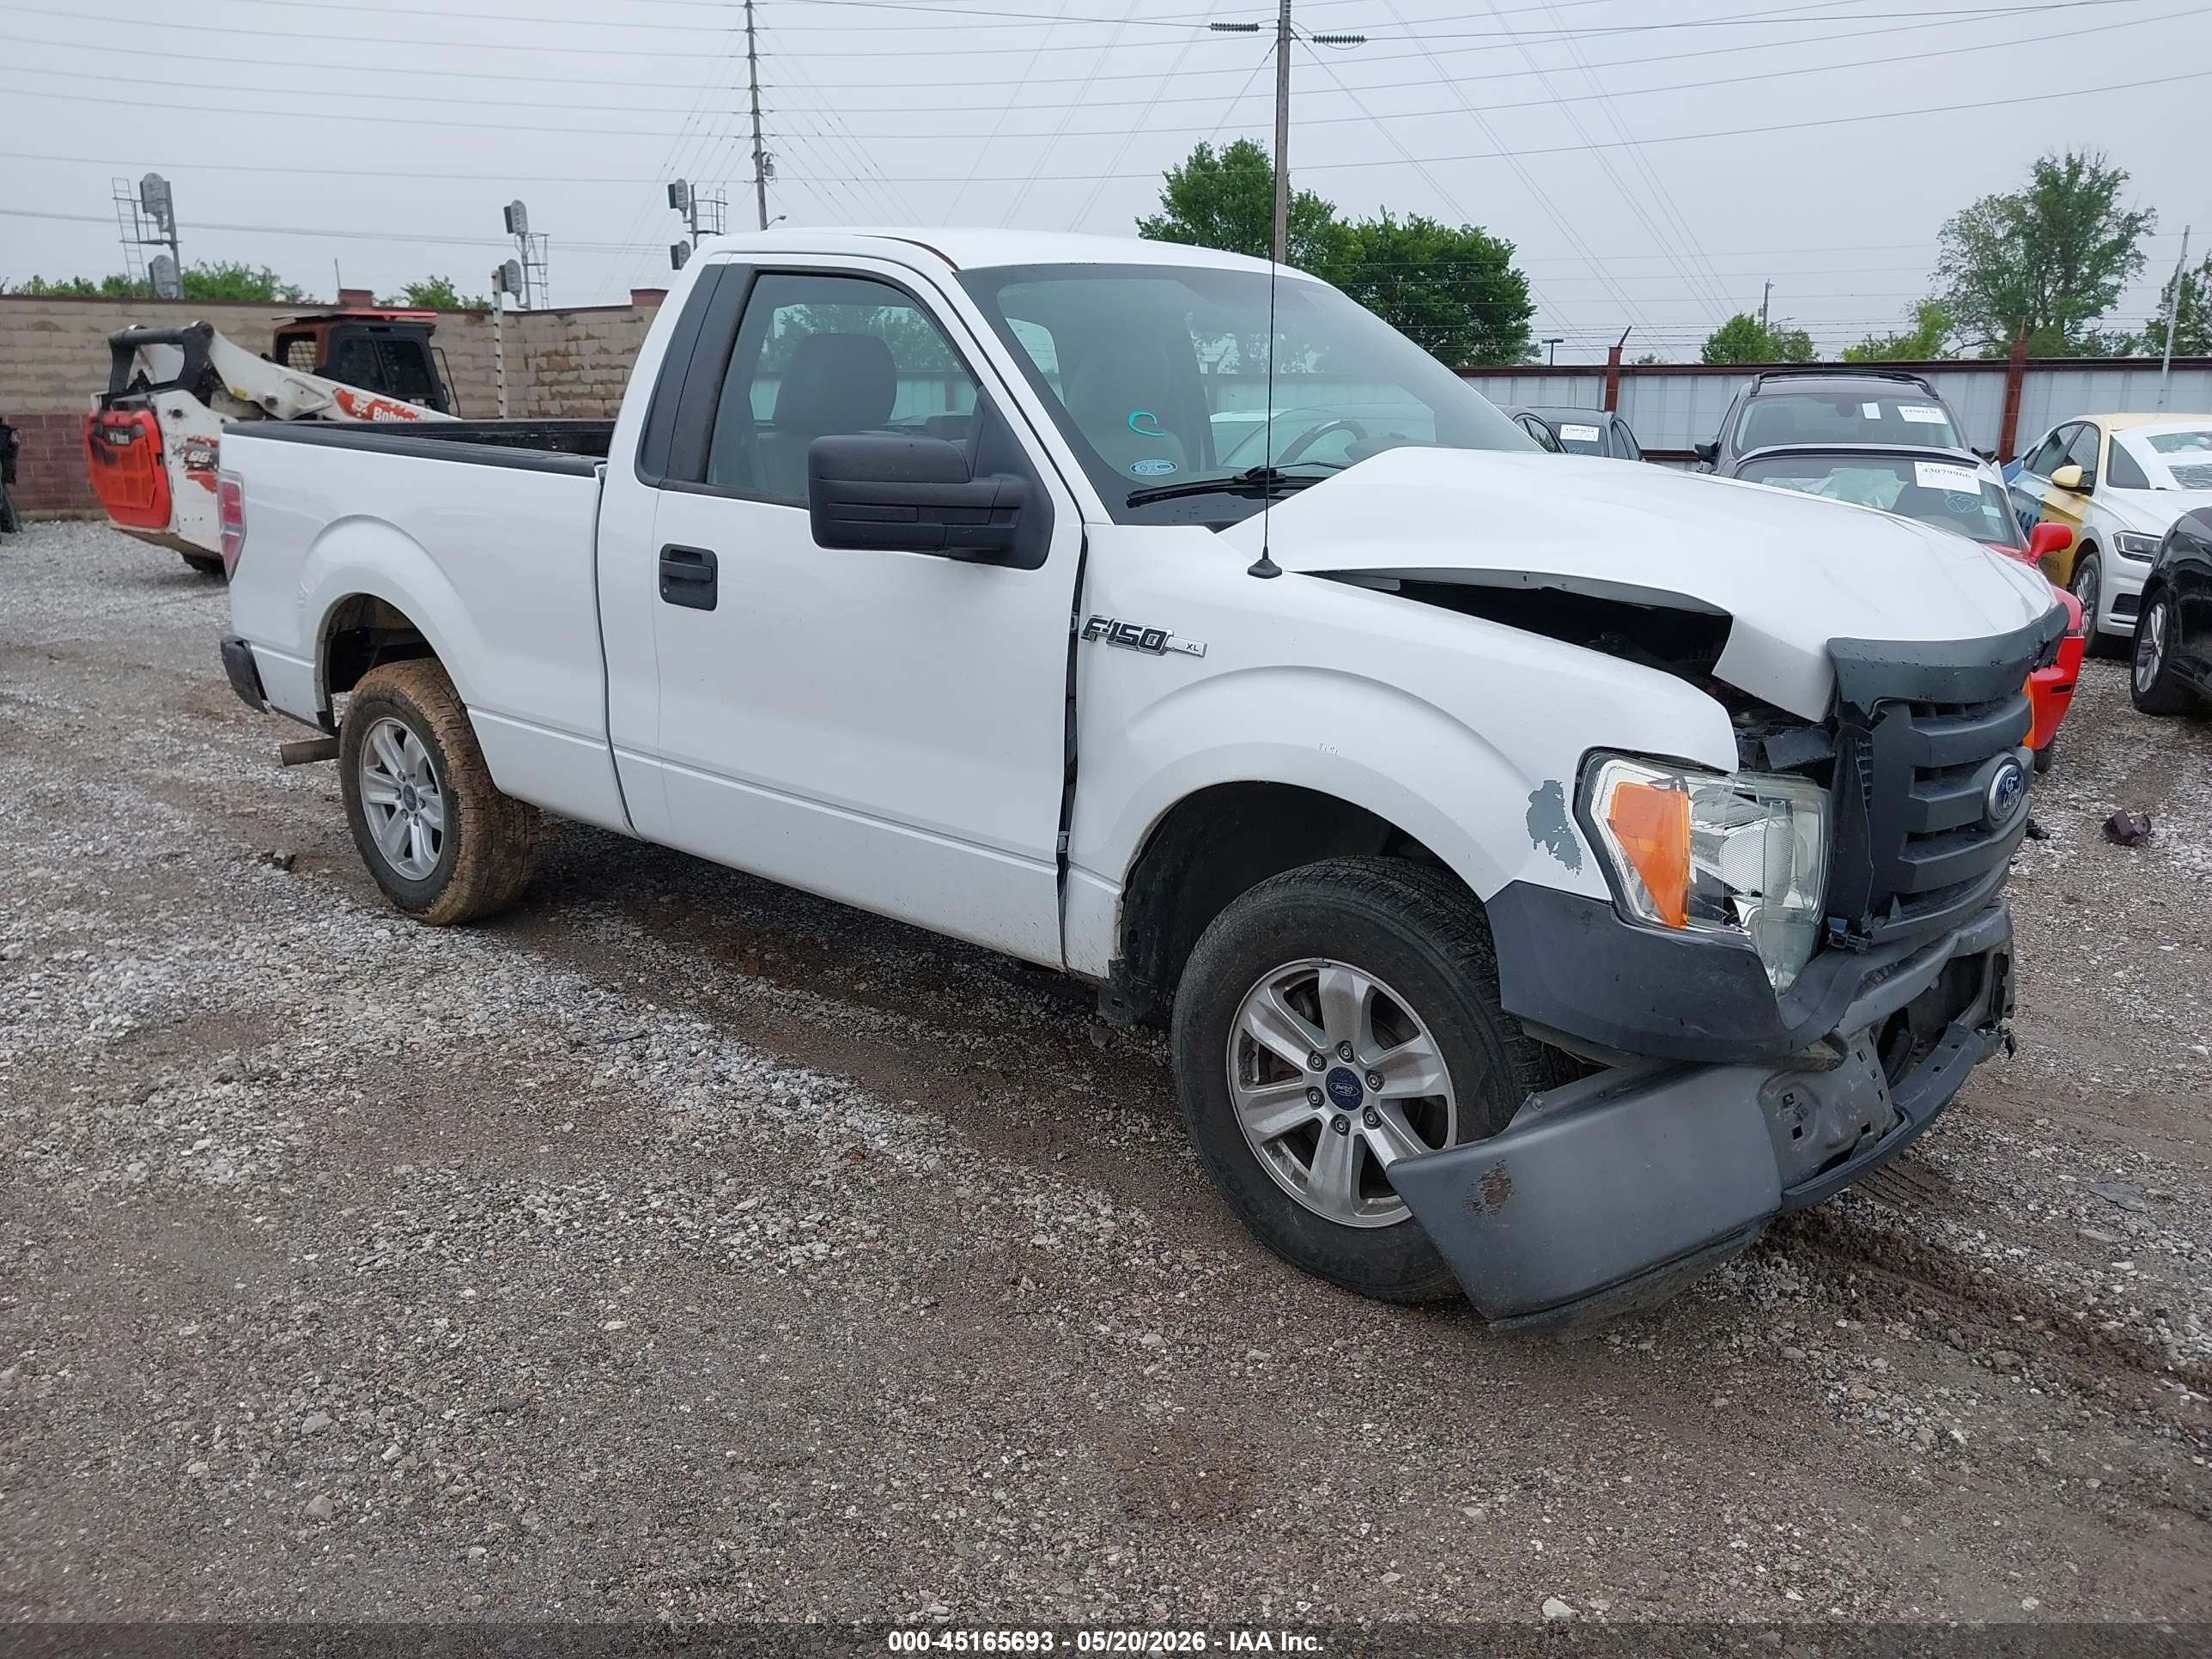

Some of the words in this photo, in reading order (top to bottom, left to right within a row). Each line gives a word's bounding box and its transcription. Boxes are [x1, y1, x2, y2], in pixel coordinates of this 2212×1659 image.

[1083, 617, 1170, 654] F-150
[1187, 642, 1200, 652] XL
[2002, 775, 2021, 808] Ford
